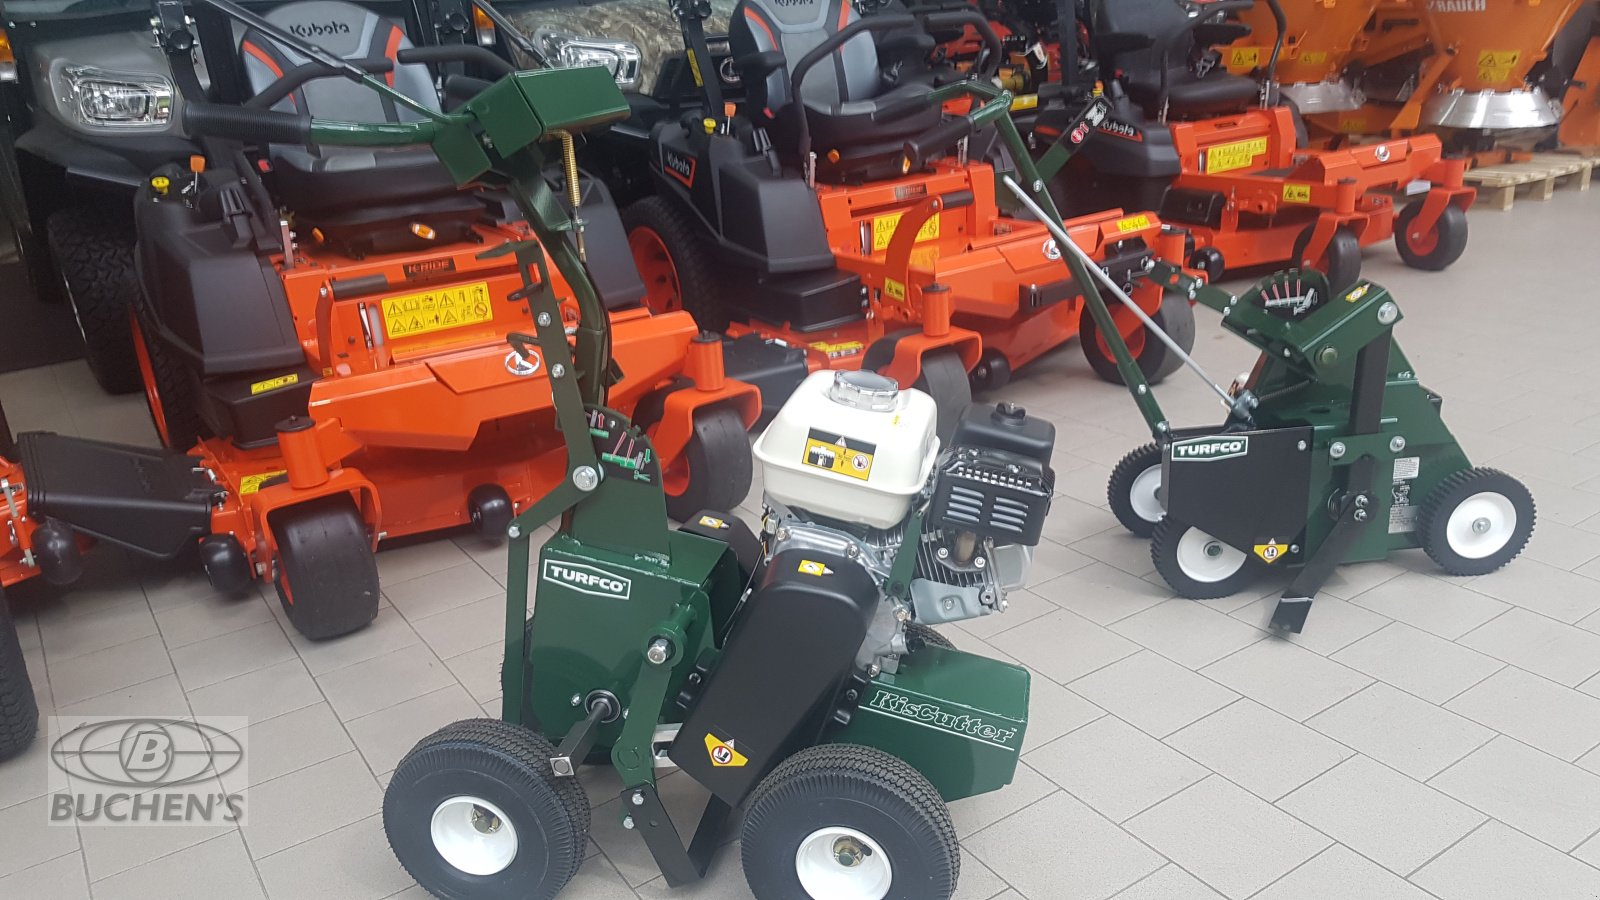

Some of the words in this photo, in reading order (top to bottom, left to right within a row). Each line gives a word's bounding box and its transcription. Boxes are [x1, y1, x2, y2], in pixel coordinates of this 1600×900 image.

[289, 20, 350, 38] Kubota
[1177, 441, 1245, 456] TURFCO
[550, 565, 627, 592] TURFCO
